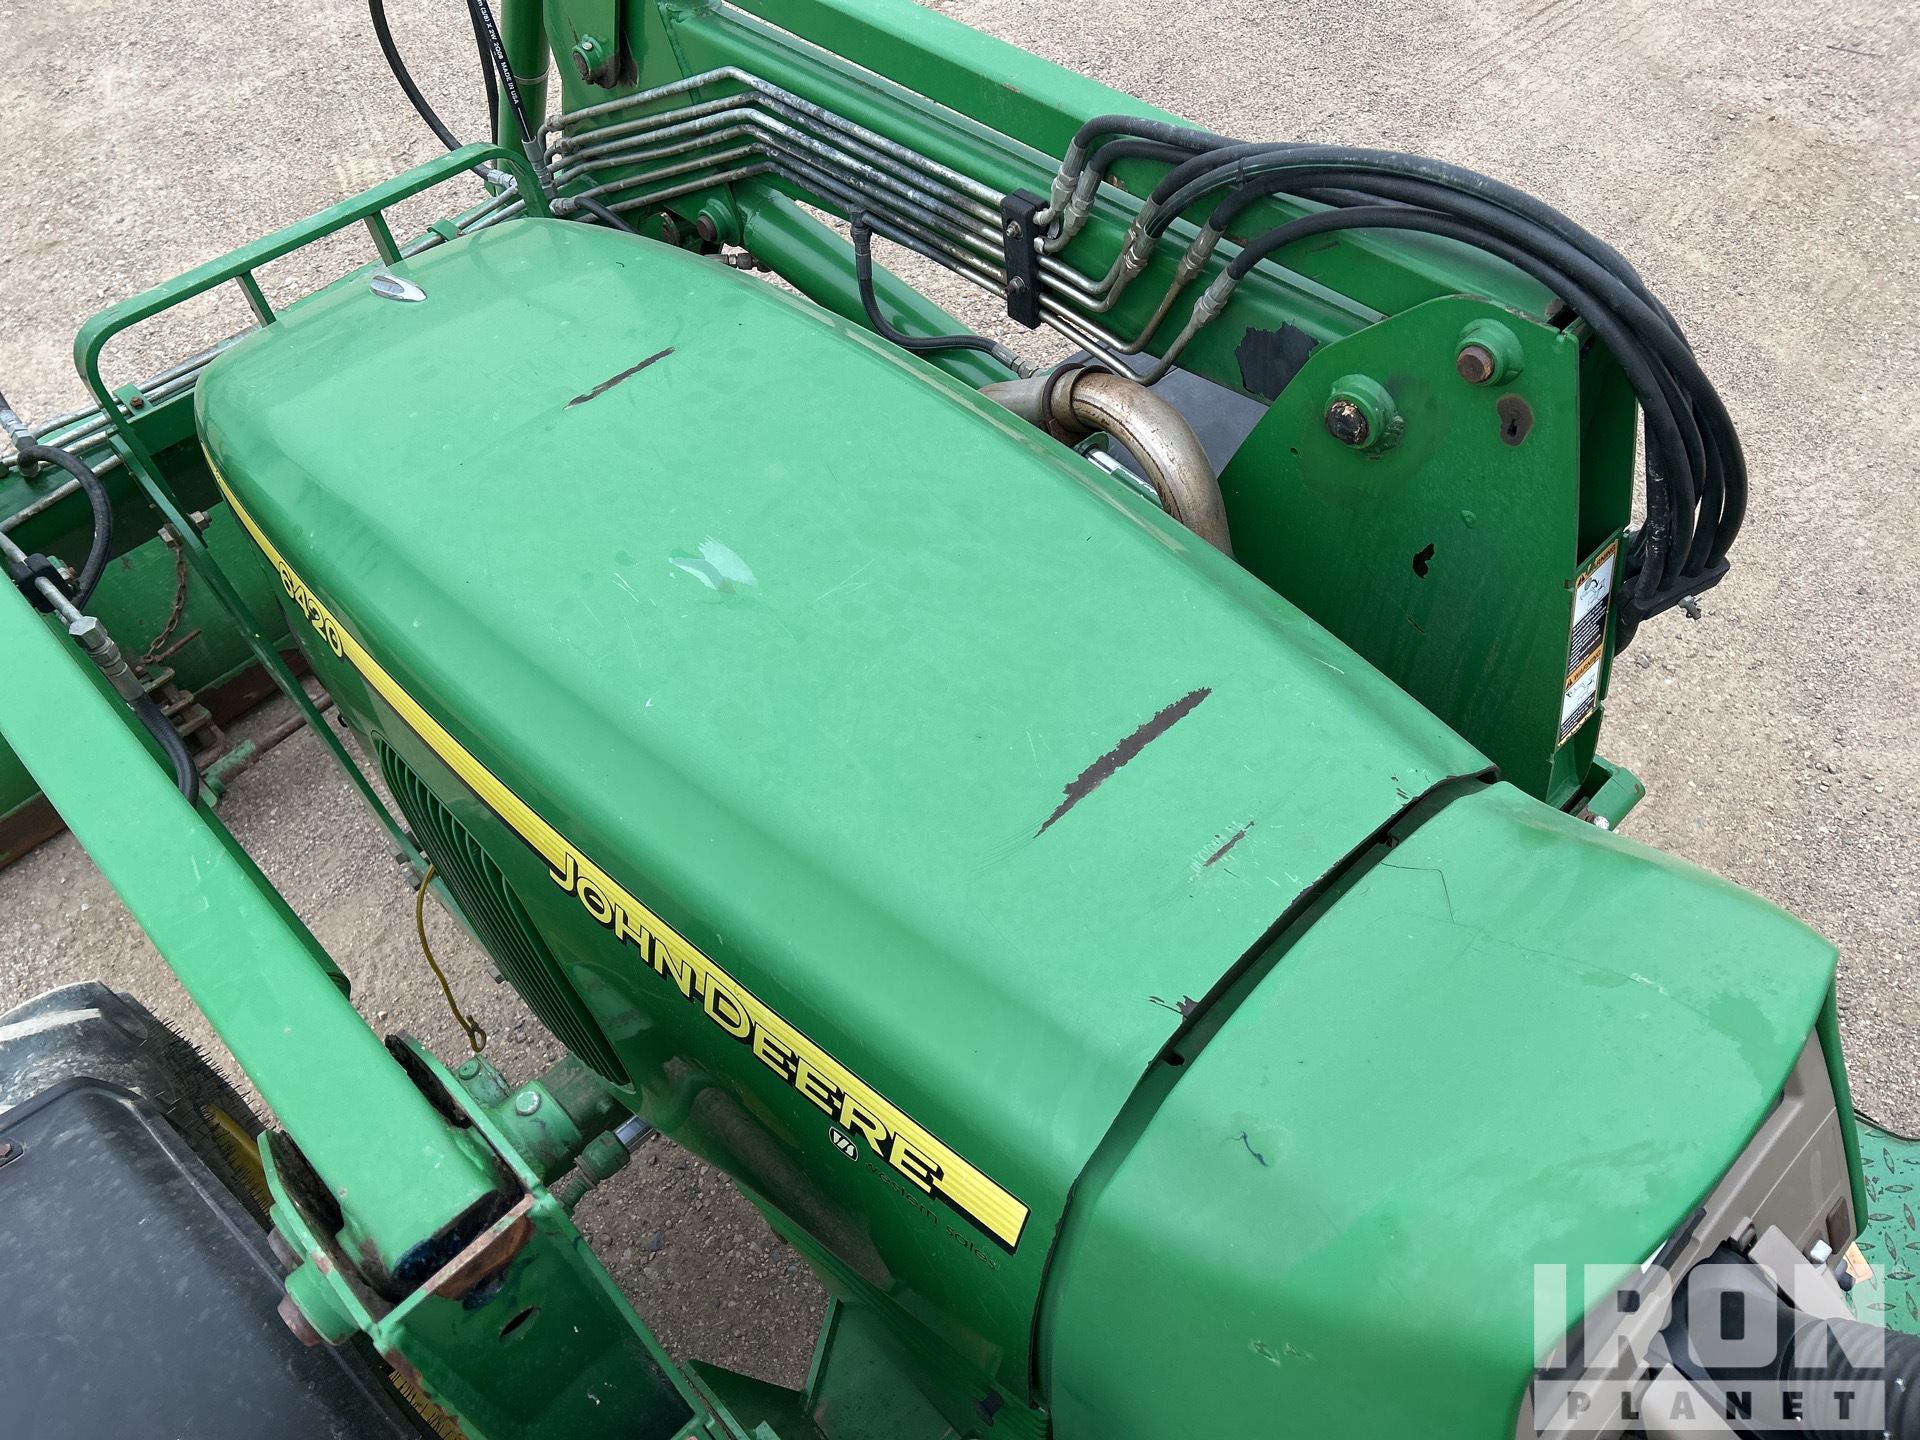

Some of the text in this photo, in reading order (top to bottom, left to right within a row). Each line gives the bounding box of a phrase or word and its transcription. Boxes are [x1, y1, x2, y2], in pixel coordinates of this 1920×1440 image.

[501, 61, 512, 82] MADE
[508, 82, 515, 90] IN
[511, 90, 519, 105] USA
[279, 561, 343, 658] 6420
[548, 852, 945, 1200] JOHN DEERE
[945, 1224, 1000, 1270] sales
